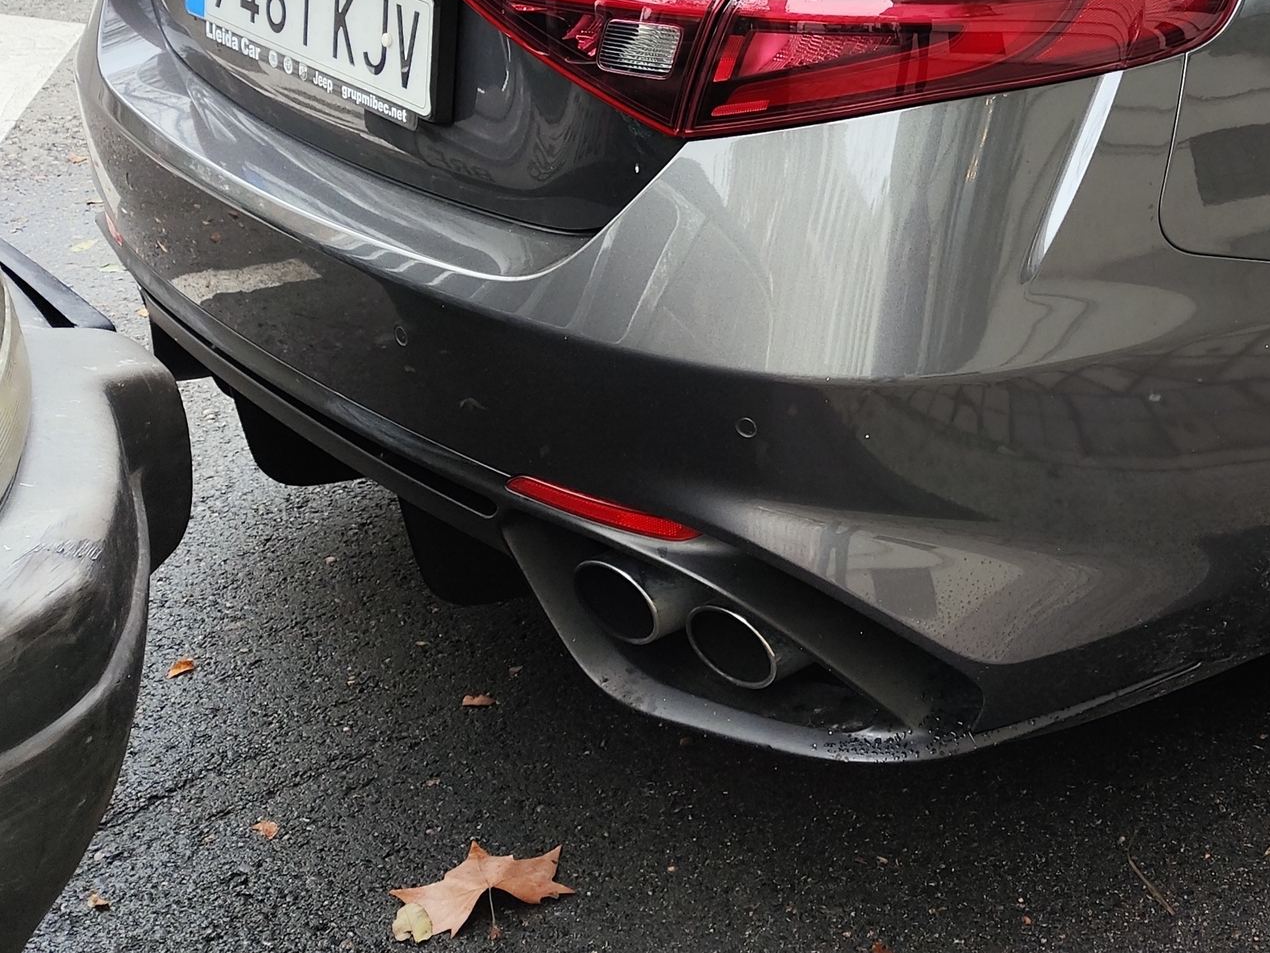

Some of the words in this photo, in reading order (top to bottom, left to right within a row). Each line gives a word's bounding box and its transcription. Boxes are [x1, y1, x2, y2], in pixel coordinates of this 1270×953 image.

[205, 20, 239, 51] Lleida
[240, 37, 261, 61] Car
[312, 70, 334, 93] Jeep
[341, 84, 407, 123] grupmibec.net
